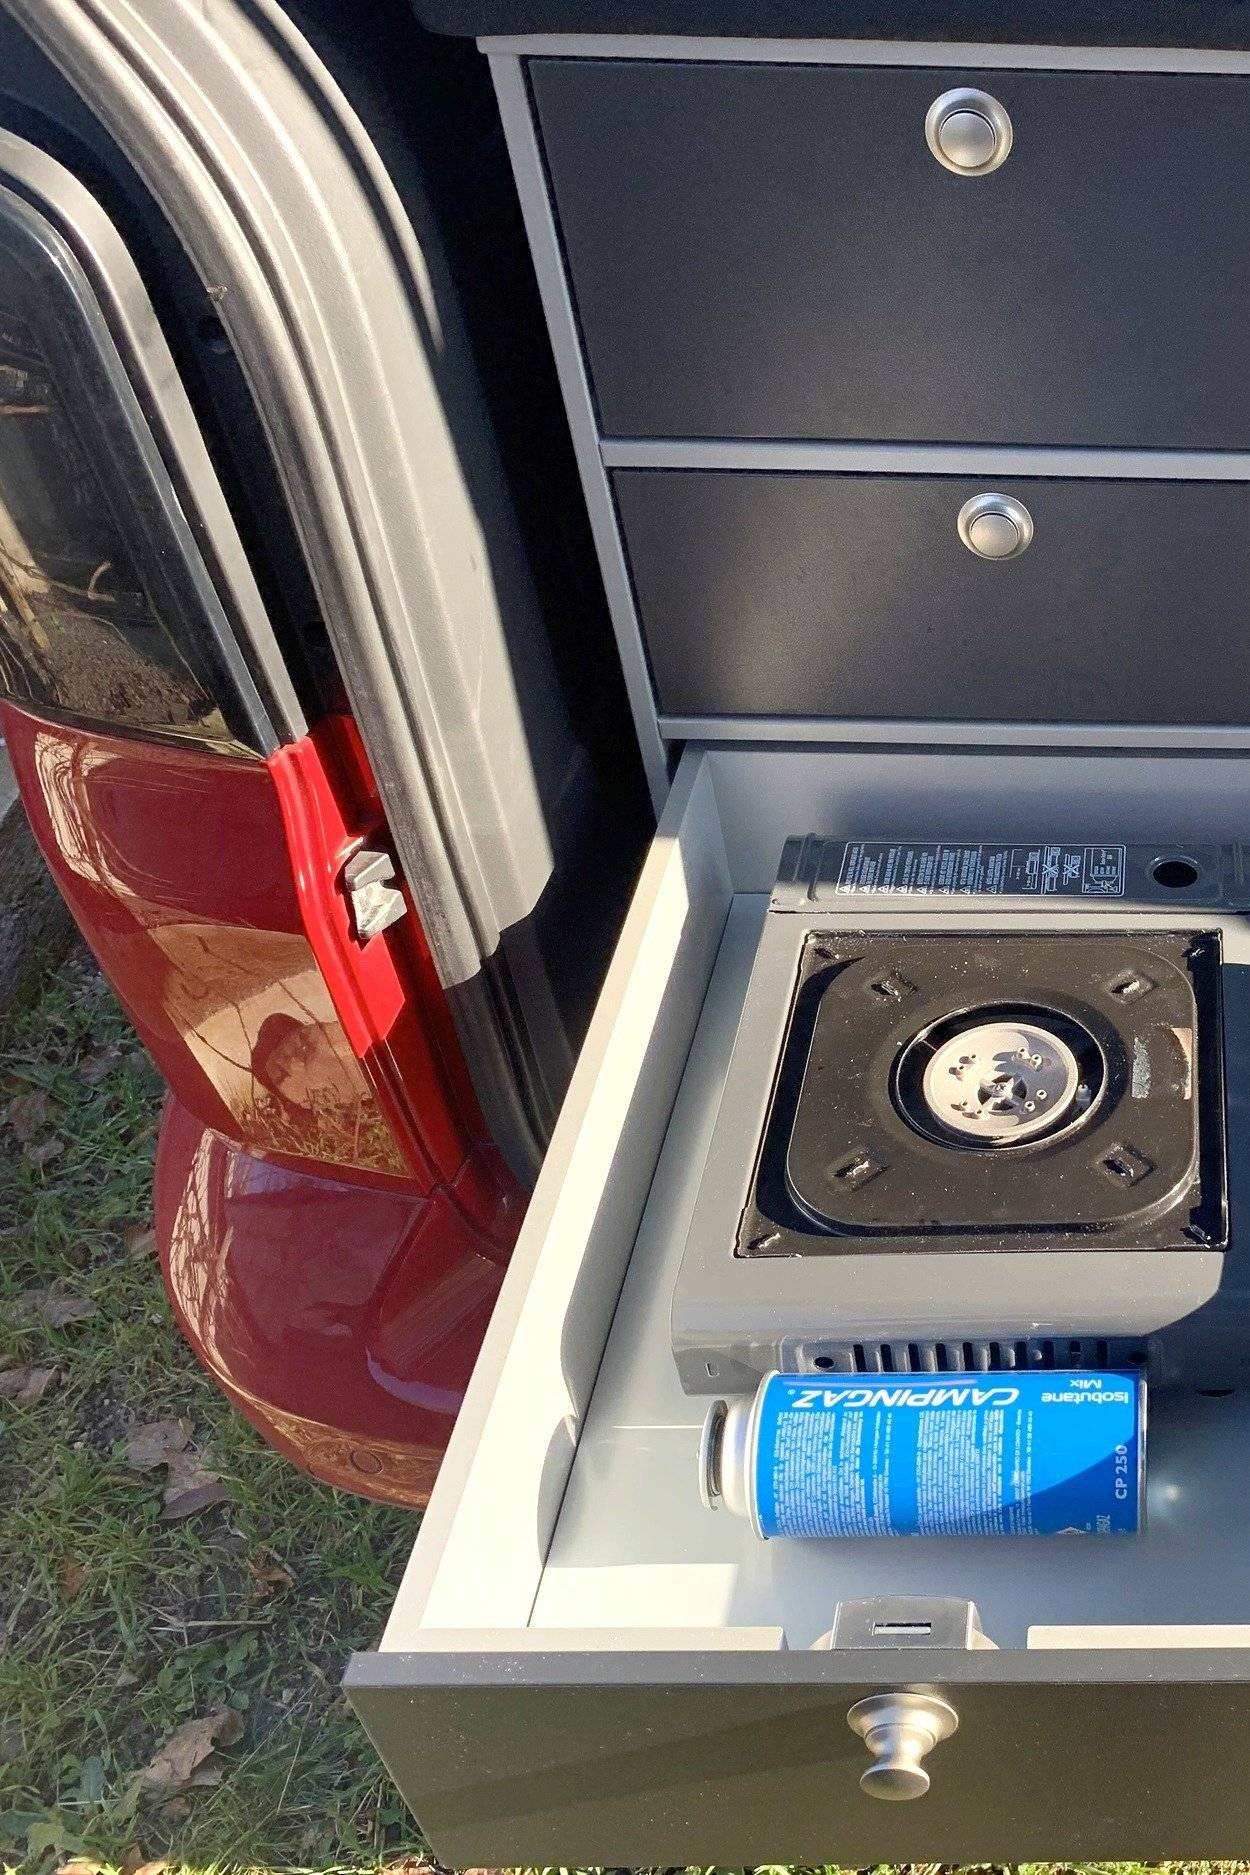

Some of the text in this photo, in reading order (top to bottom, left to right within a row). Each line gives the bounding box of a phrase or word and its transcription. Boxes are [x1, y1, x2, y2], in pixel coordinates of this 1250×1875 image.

[1069, 1379, 1102, 1389] Mix
[791, 1387, 1021, 1408] CAMPINGAZ
[1041, 1391, 1129, 1404] Isobutane
[1115, 1444, 1128, 1500] CP 250
